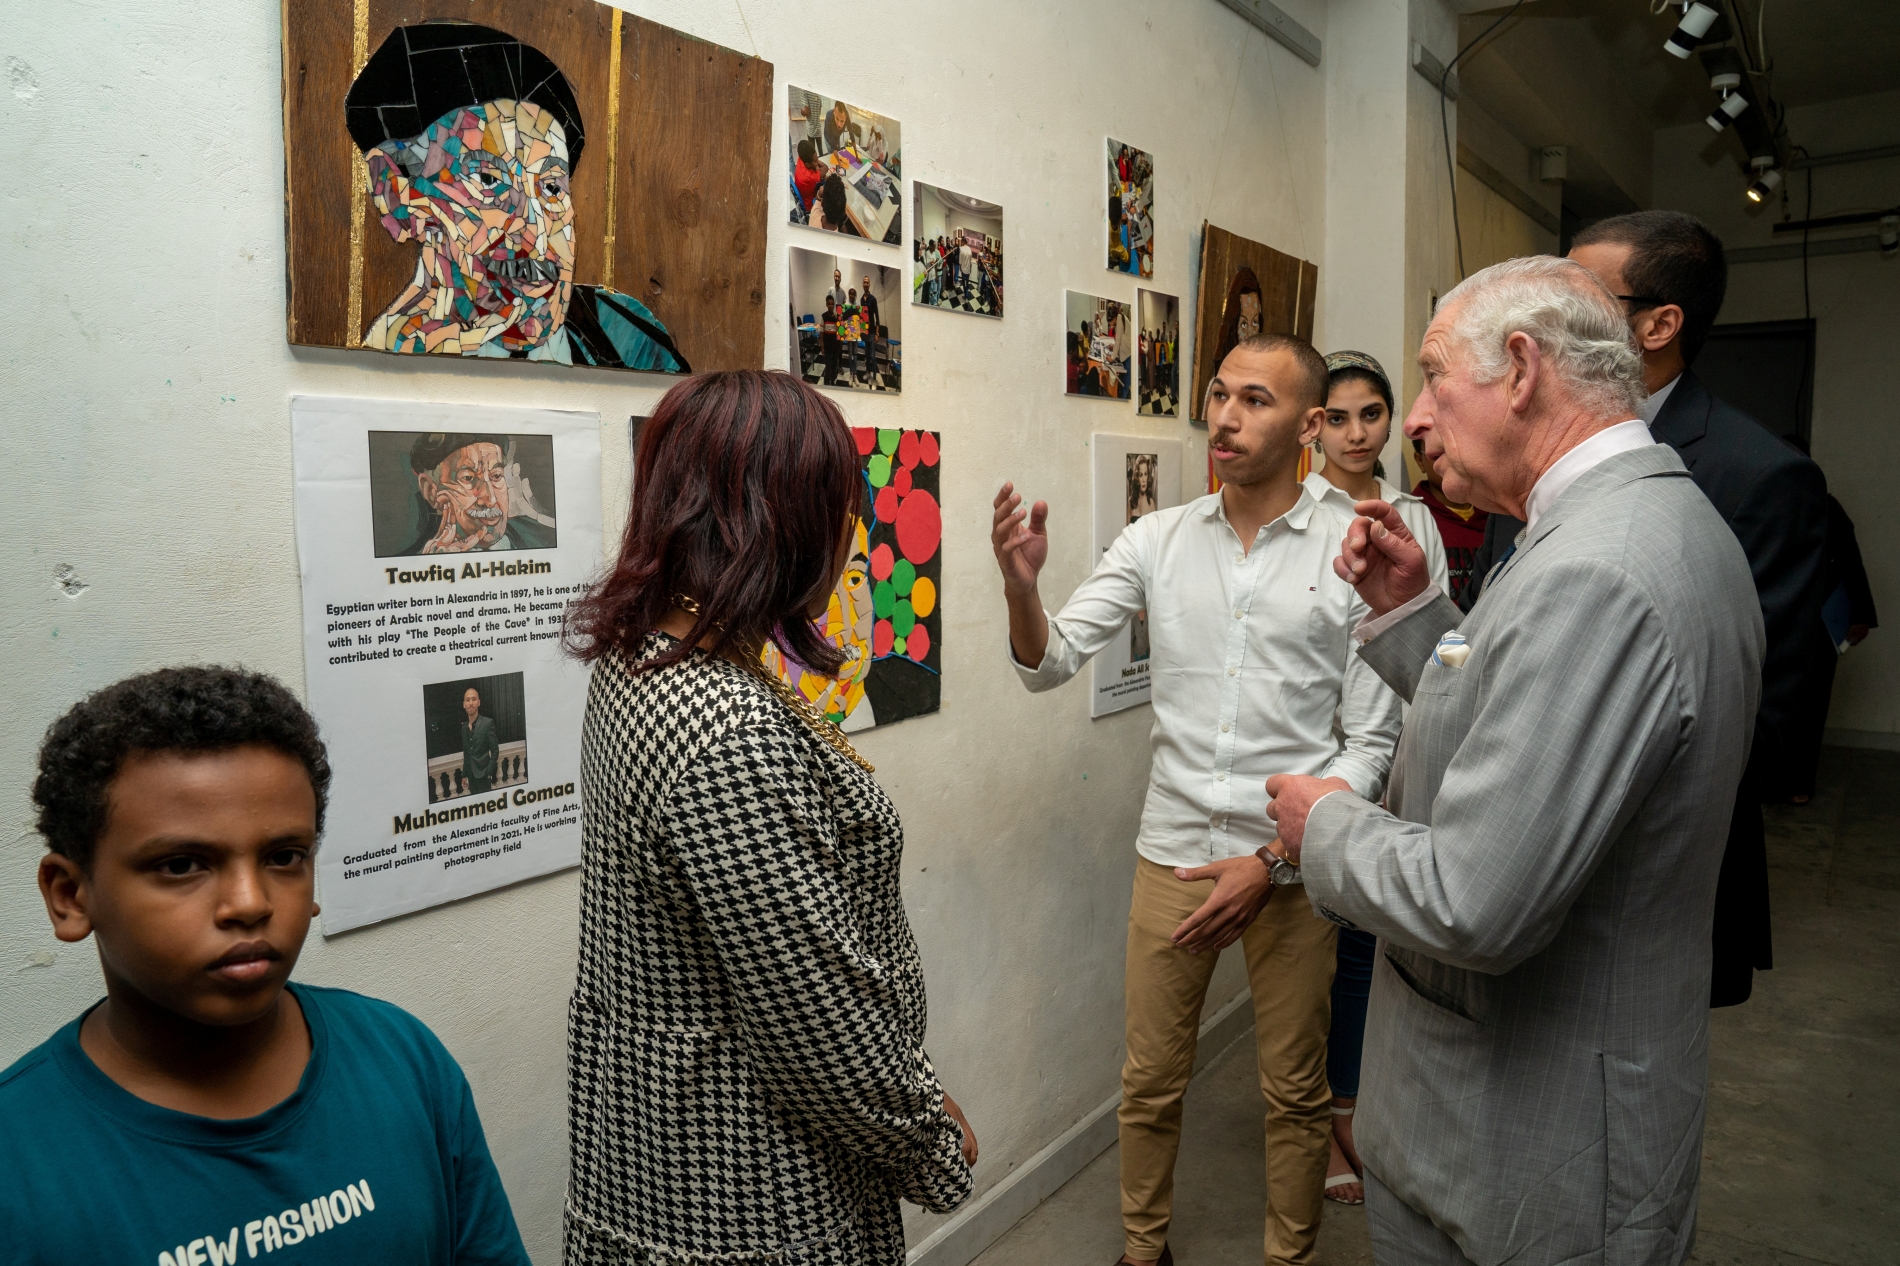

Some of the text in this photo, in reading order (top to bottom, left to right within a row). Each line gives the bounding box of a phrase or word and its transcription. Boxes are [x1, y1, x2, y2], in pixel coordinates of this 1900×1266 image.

[385, 559, 551, 584] Tawfiq Al-Hakim
[326, 602, 375, 616] Egyptian
[377, 599, 408, 610] writer
[410, 597, 433, 607] born
[435, 595, 445, 605] in
[447, 591, 498, 604] Alexandria
[500, 590, 508, 599] in
[510, 589, 531, 599] 1897,
[533, 587, 544, 596] he
[546, 586, 552, 595] is
[555, 586, 570, 595] one
[572, 583, 580, 593] of
[327, 620, 371, 633] pioneers
[375, 616, 385, 626] of
[389, 613, 423, 625] Arabic
[426, 610, 452, 621] novel
[455, 608, 474, 619] and
[478, 607, 510, 617] drama.
[514, 603, 526, 613] He
[529, 601, 563, 611] became
[328, 636, 352, 648] with
[358, 634, 372, 645] his
[378, 632, 400, 644] play
[434, 624, 466, 636] People
[471, 622, 480, 632] of
[485, 621, 500, 631] the
[535, 616, 543, 625] in
[329, 648, 389, 665] contributed
[392, 648, 403, 657] to
[406, 644, 437, 655] create
[440, 644, 446, 652] a
[449, 636, 493, 650] theatrical
[496, 633, 527, 644] current
[530, 631, 559, 641] known
[455, 655, 488, 665] Drama
[393, 782, 575, 834] Muhammed Gomaa
[343, 803, 580, 865] Graduated from the Alexandria faculty of Fine Arts,
[344, 869, 360, 880] the
[363, 860, 392, 875] mural
[394, 851, 434, 869] painting
[436, 836, 489, 857] department
[491, 835, 499, 844] in
[501, 829, 522, 840] 2021.
[523, 826, 535, 835] He
[537, 823, 543, 832] is
[544, 816, 576, 830] working
[444, 841, 521, 870] photography field
[158, 1179, 375, 1266] NEW FASHION
